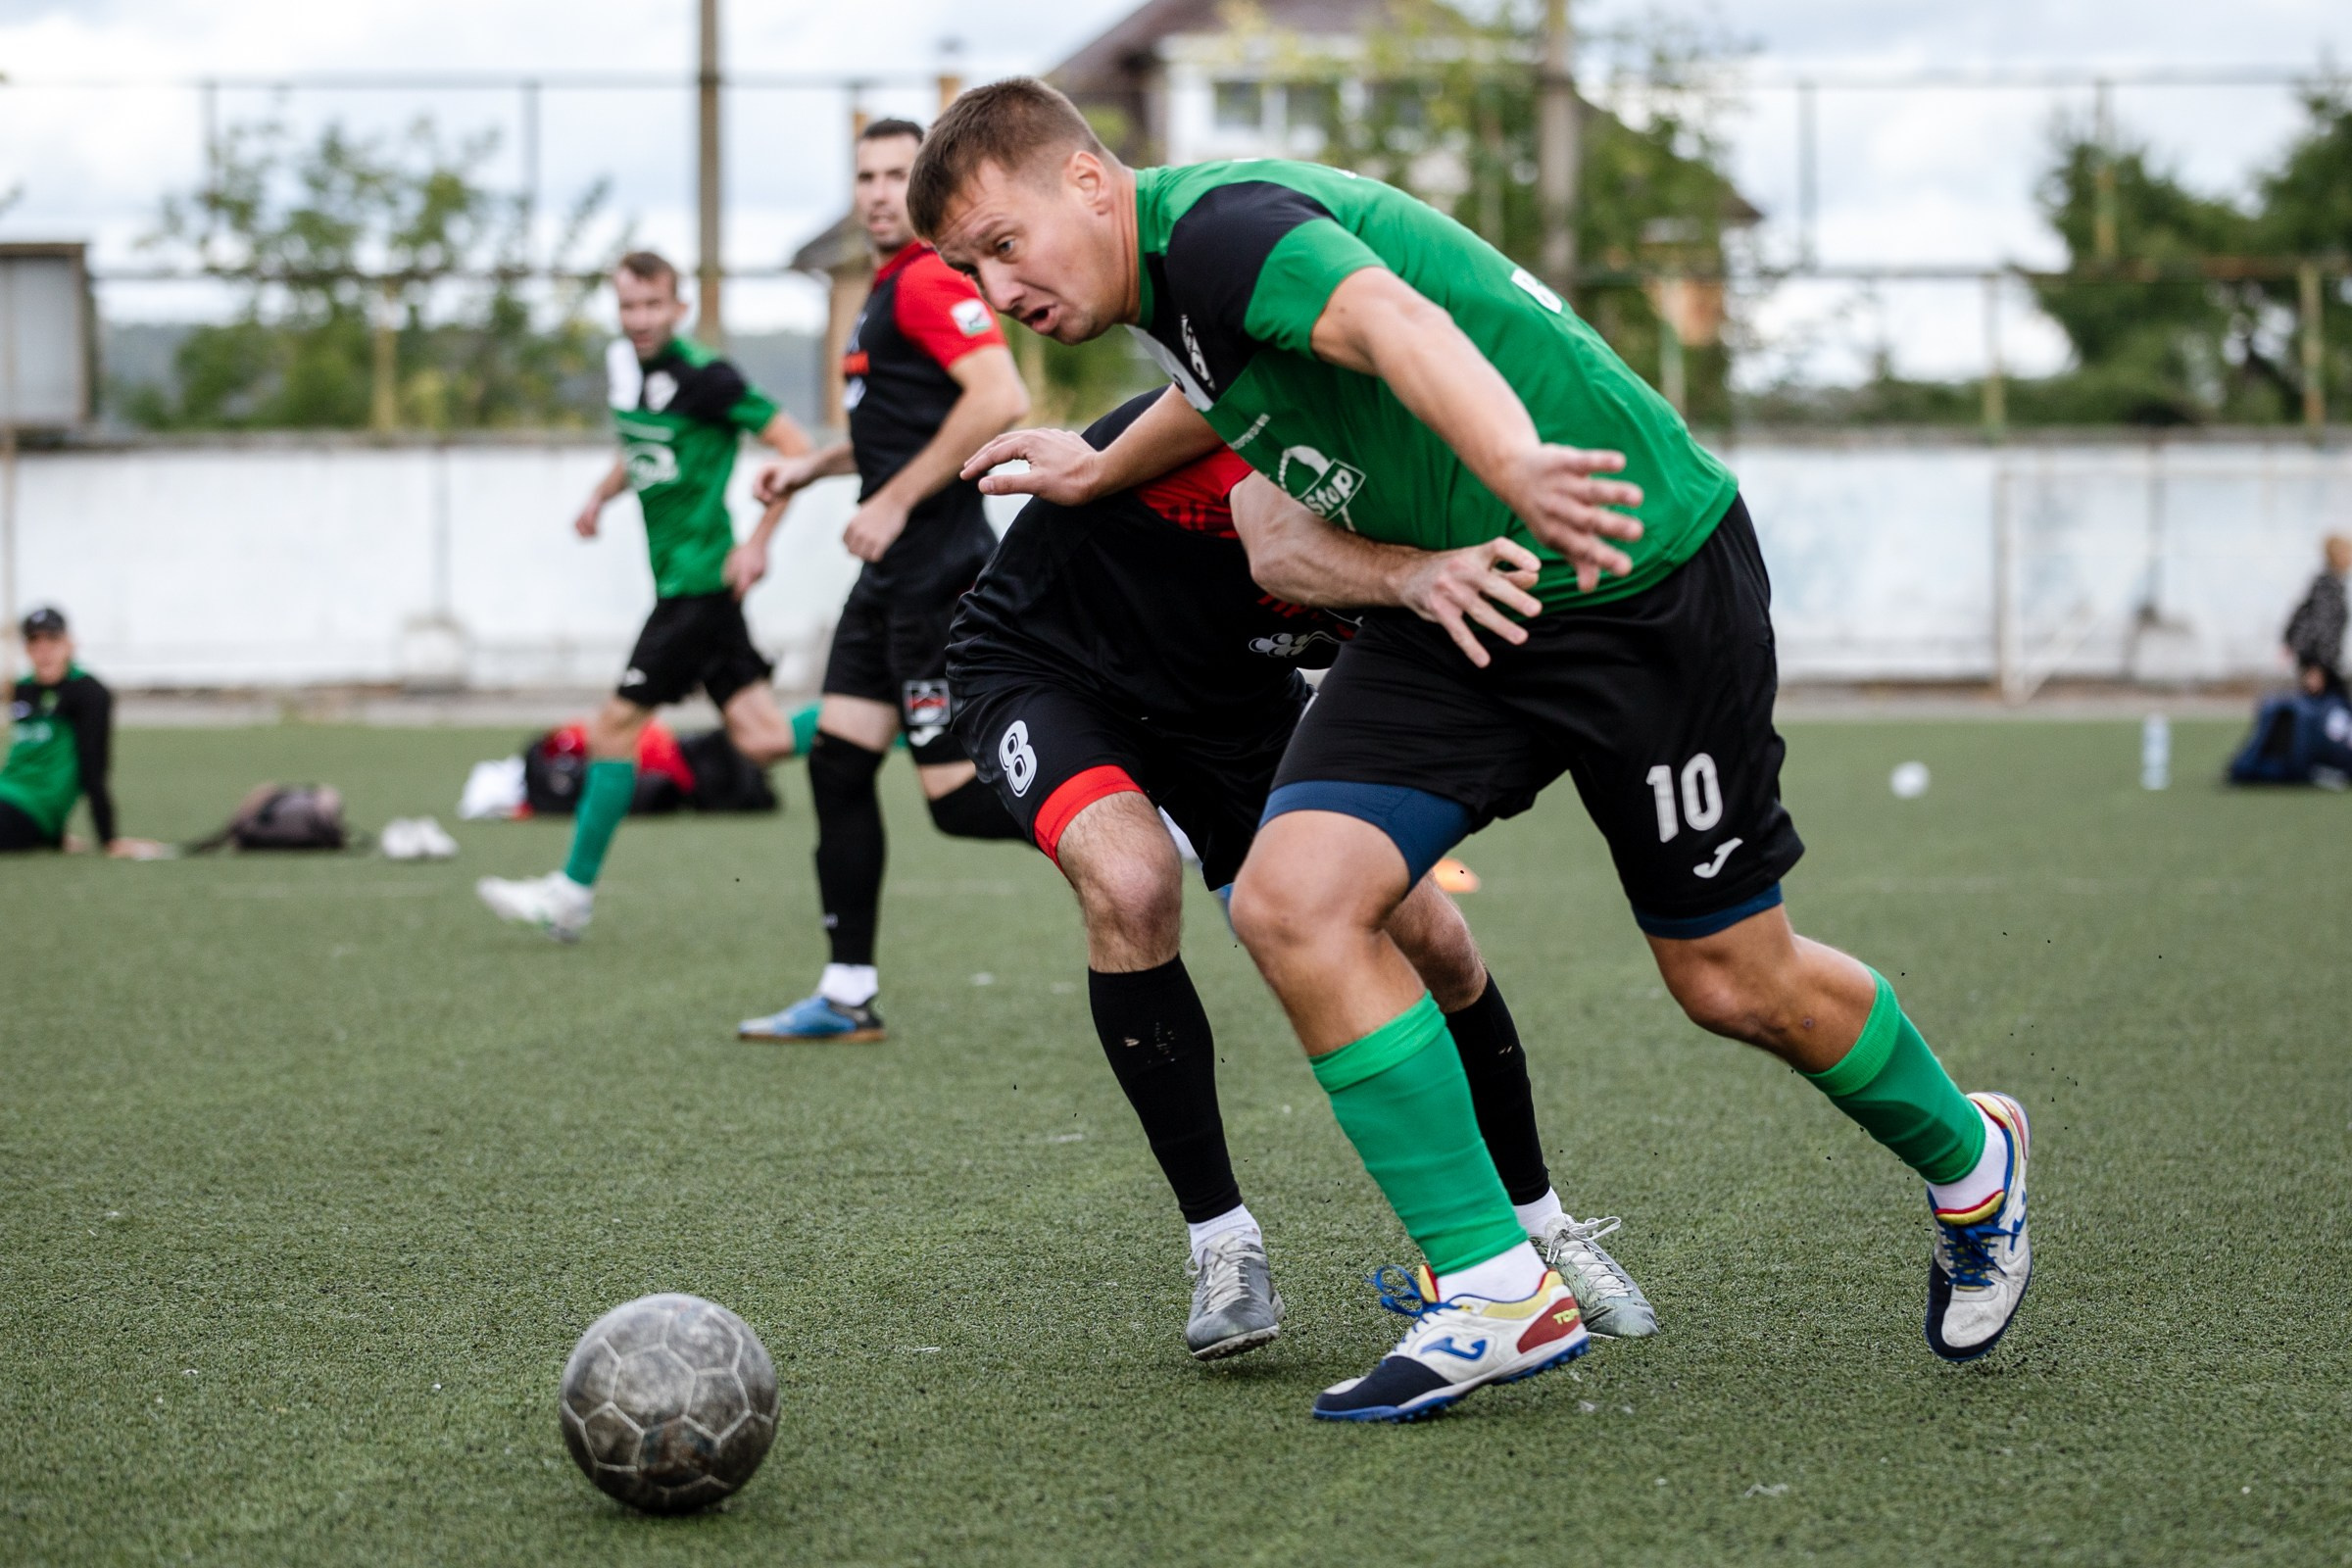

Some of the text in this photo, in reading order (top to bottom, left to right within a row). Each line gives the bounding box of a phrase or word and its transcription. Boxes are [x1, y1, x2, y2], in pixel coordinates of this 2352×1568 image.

[1304, 467, 1354, 516] Stop
[999, 719, 1038, 798] 8
[1645, 752, 1723, 844] 10
